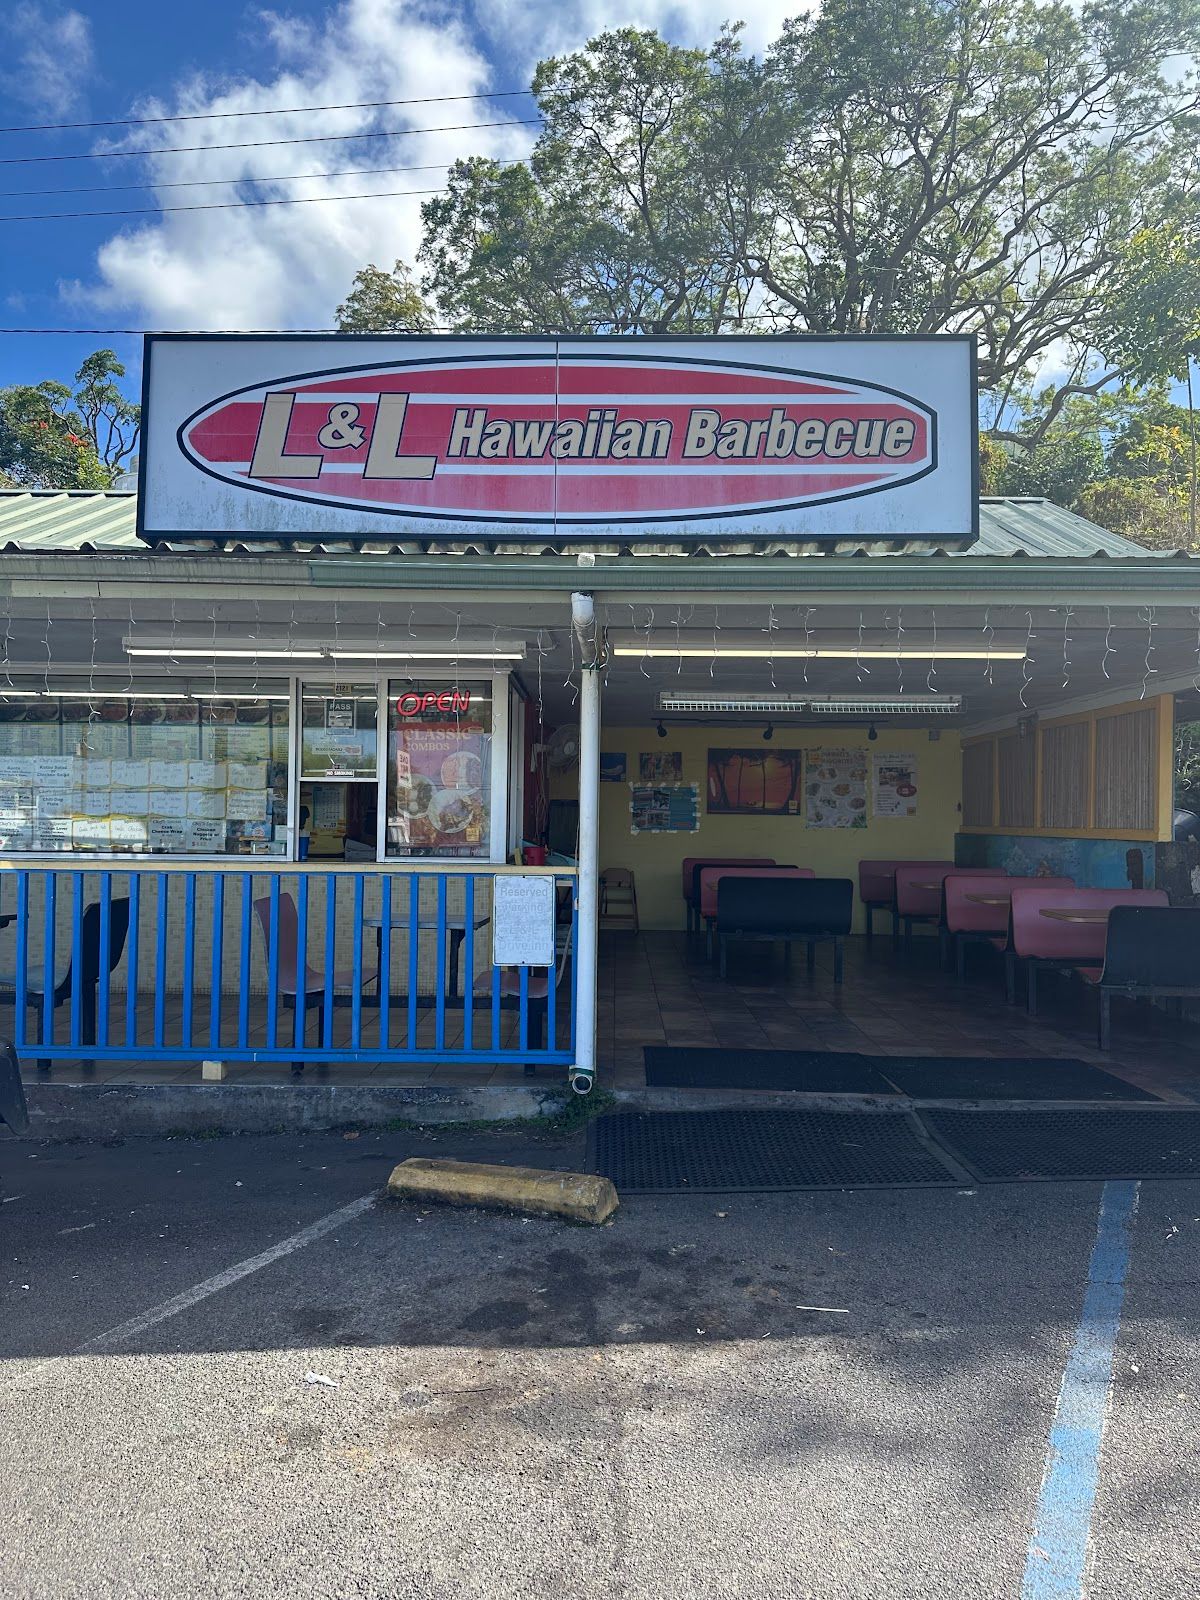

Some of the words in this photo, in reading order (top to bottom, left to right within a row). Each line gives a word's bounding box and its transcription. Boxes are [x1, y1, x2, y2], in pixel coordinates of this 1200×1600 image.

[446, 408, 673, 459] Hawaiian
[682, 408, 916, 459] Barbecue
[397, 689, 471, 717] OPEN
[405, 728, 472, 741] CLASSIC
[406, 742, 450, 752] COMBOS
[500, 887, 548, 897] Reserved
